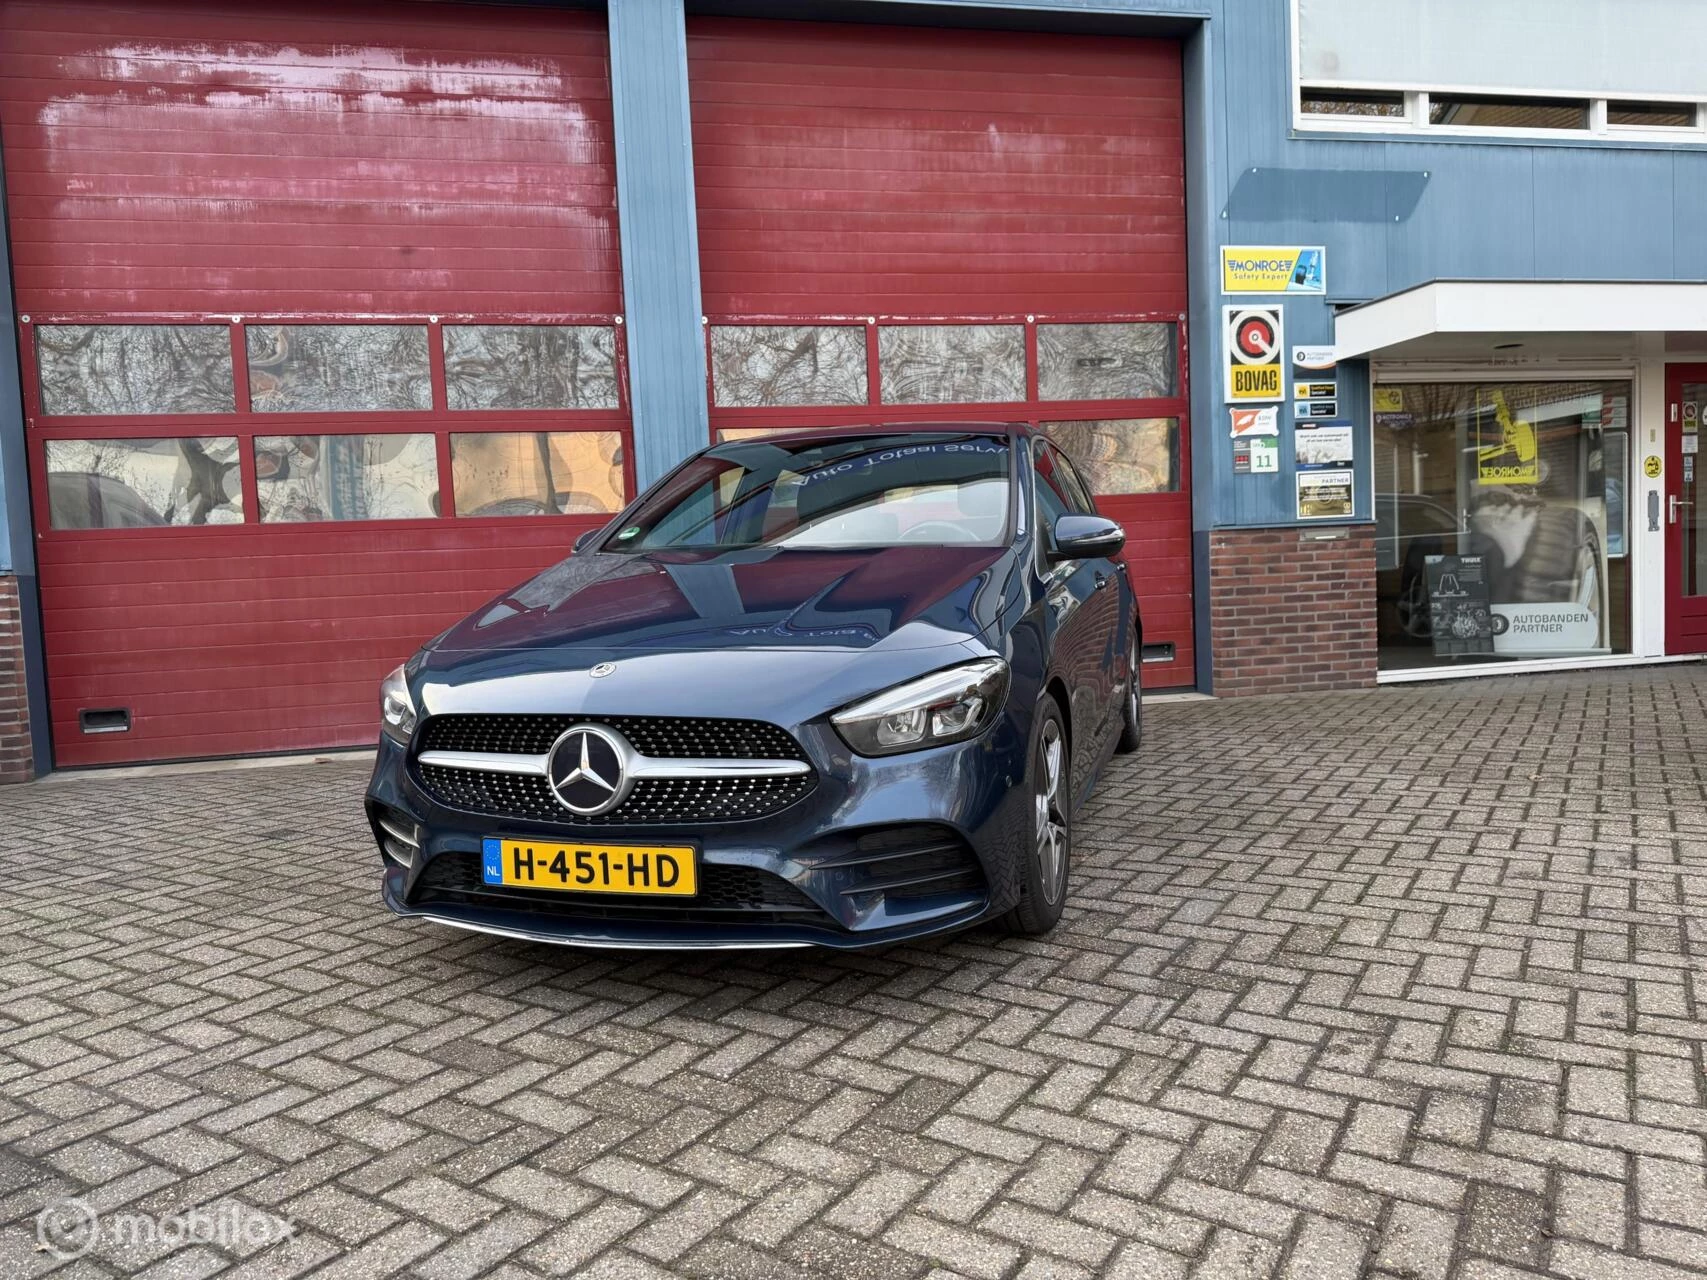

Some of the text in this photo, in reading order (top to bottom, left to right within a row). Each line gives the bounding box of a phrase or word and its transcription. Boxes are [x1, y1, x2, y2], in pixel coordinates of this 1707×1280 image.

[1235, 260, 1288, 272] MONROE
[1234, 273, 1288, 281] Safety Expert
[1235, 370, 1277, 392] BOVAG
[1256, 455, 1273, 468] 11
[1513, 613, 1589, 624] AUTOBANDEN
[1514, 624, 1563, 633] PARTNER
[487, 865, 500, 877] NL
[513, 847, 680, 888] H-451-HD
